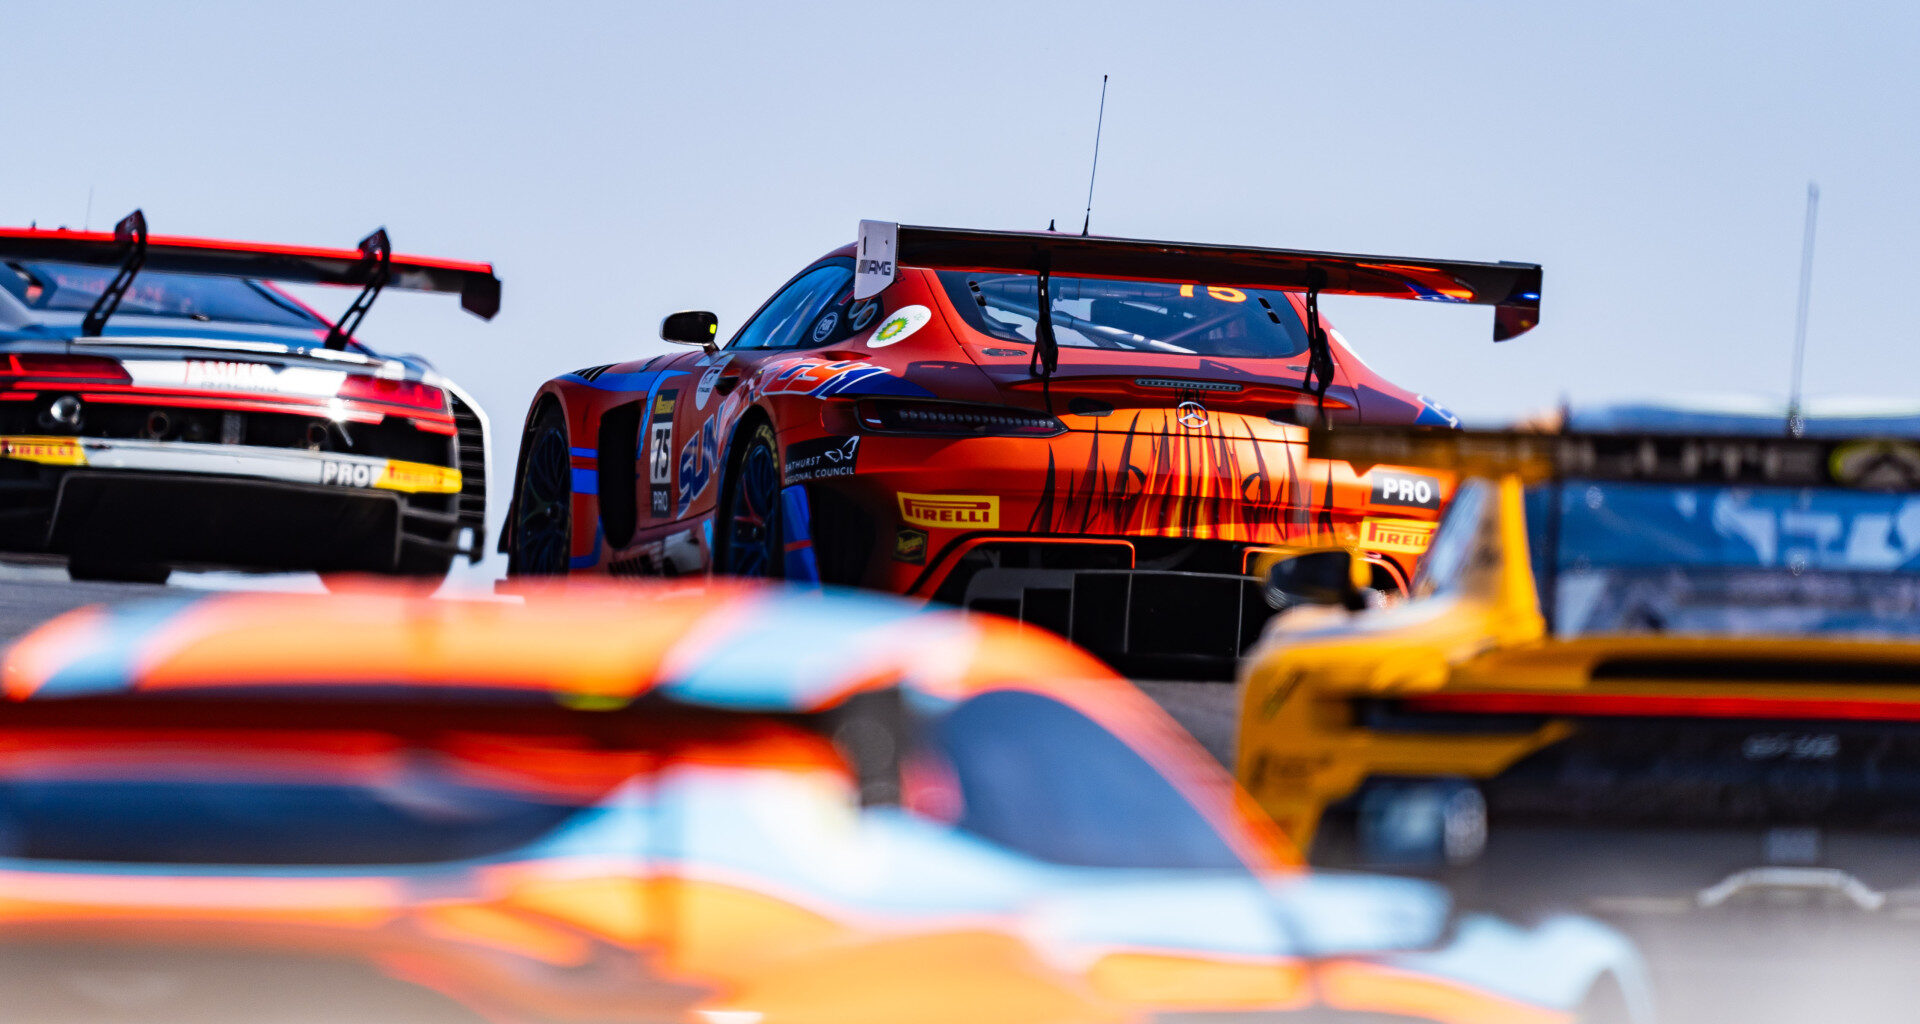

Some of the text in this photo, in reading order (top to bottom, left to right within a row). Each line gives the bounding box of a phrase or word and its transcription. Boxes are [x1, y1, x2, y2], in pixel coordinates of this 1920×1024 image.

[866, 260, 892, 276] AMG
[655, 429, 671, 479] 75
[322, 461, 370, 487] PRO
[814, 466, 855, 478] COUNCIL
[653, 491, 669, 512] PRO
[1382, 478, 1431, 504] PRO
[903, 498, 991, 523] PIRELLI
